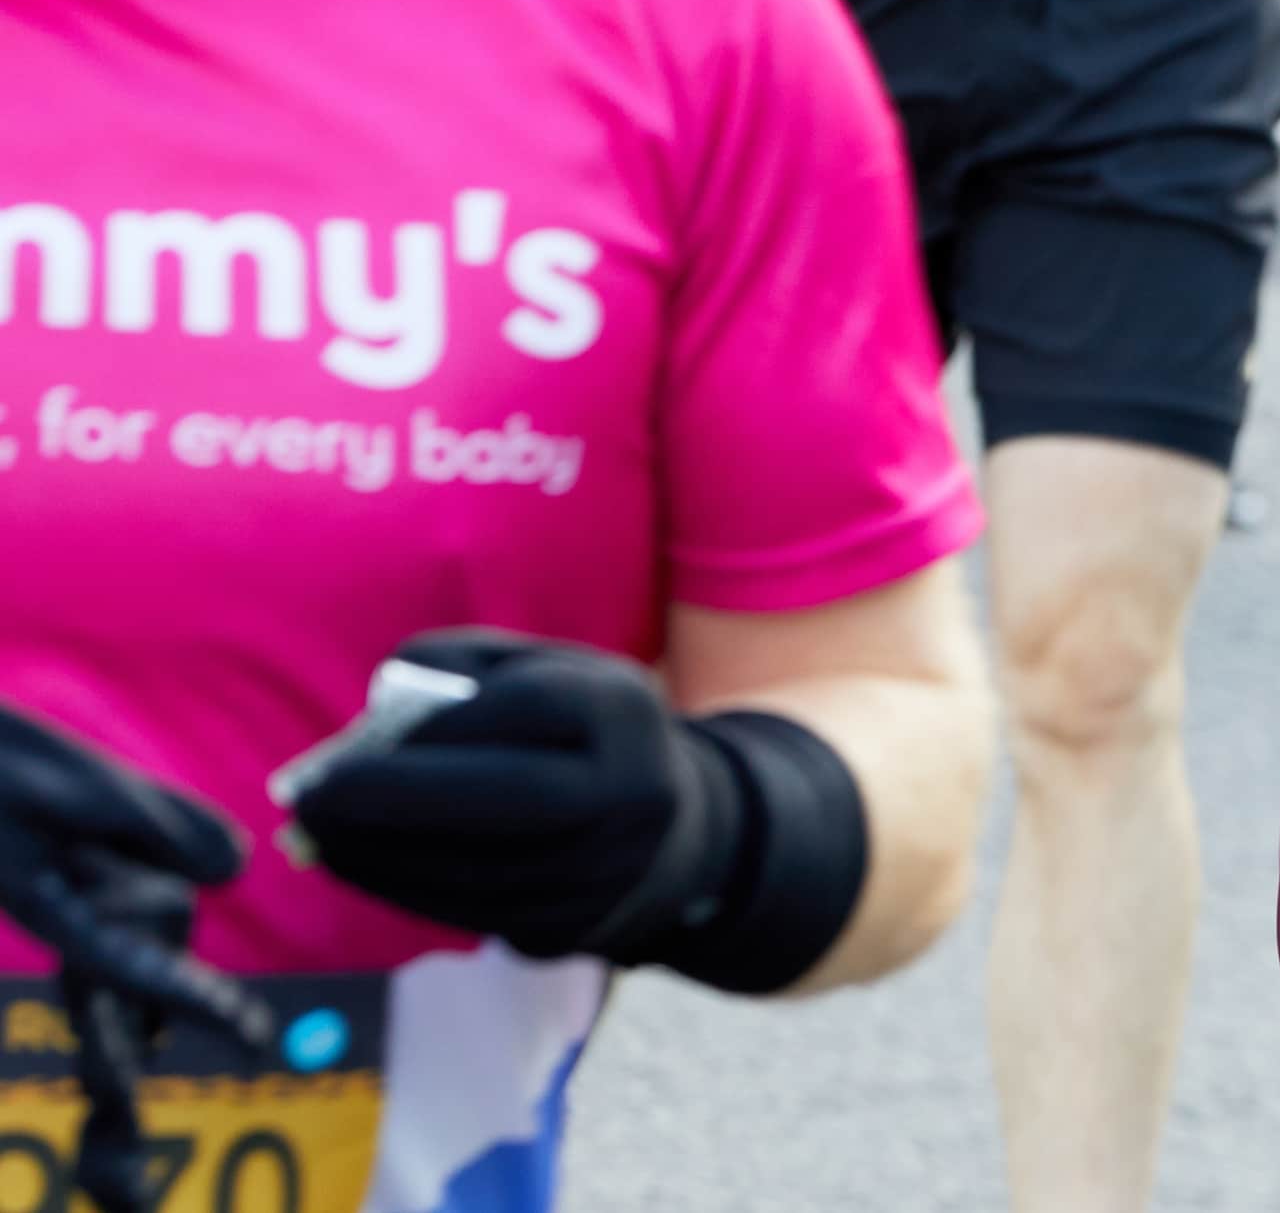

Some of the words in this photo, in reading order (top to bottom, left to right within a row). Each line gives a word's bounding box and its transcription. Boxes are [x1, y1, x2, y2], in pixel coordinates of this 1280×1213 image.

[37, 384, 156, 464] for
[168, 412, 396, 493] every
[409, 405, 585, 497] baby
